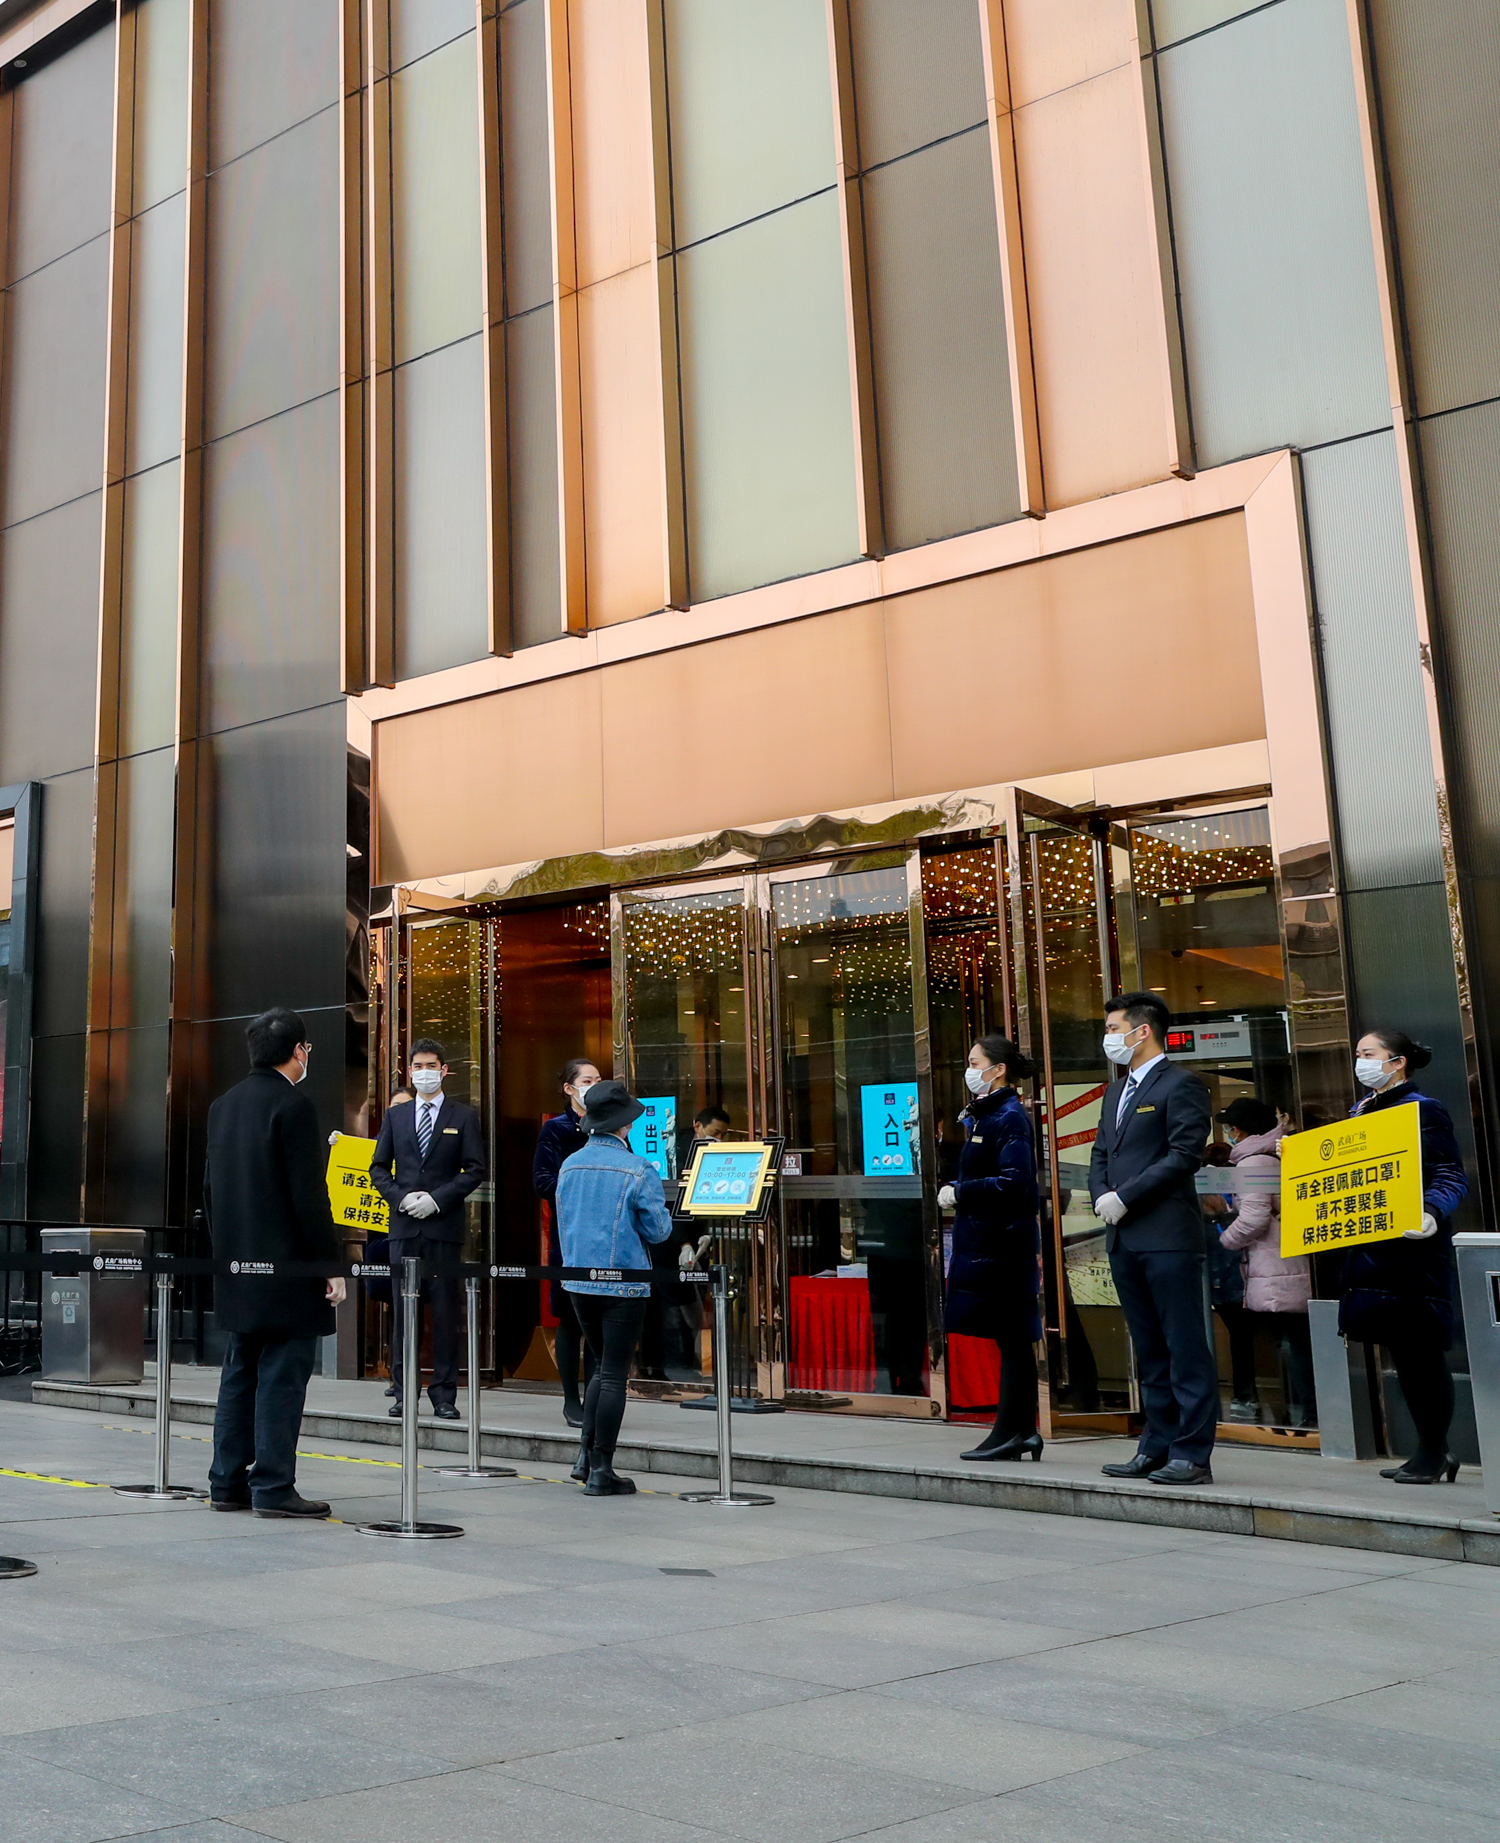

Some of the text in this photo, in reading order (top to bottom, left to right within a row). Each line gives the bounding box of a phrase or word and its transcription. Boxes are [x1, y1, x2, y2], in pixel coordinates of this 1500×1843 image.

[645, 1124, 657, 1154] 出口
[884, 1113, 899, 1147] 入口
[785, 1155, 796, 1168] 拉
[1296, 1160, 1400, 1201] 请全程佩戴口罩！
[360, 1193, 389, 1210] 请不
[1316, 1189, 1387, 1221] 请不要聚集
[1302, 1211, 1394, 1246] 保持安全距离！
[1103, 1279, 1113, 1287] NE
